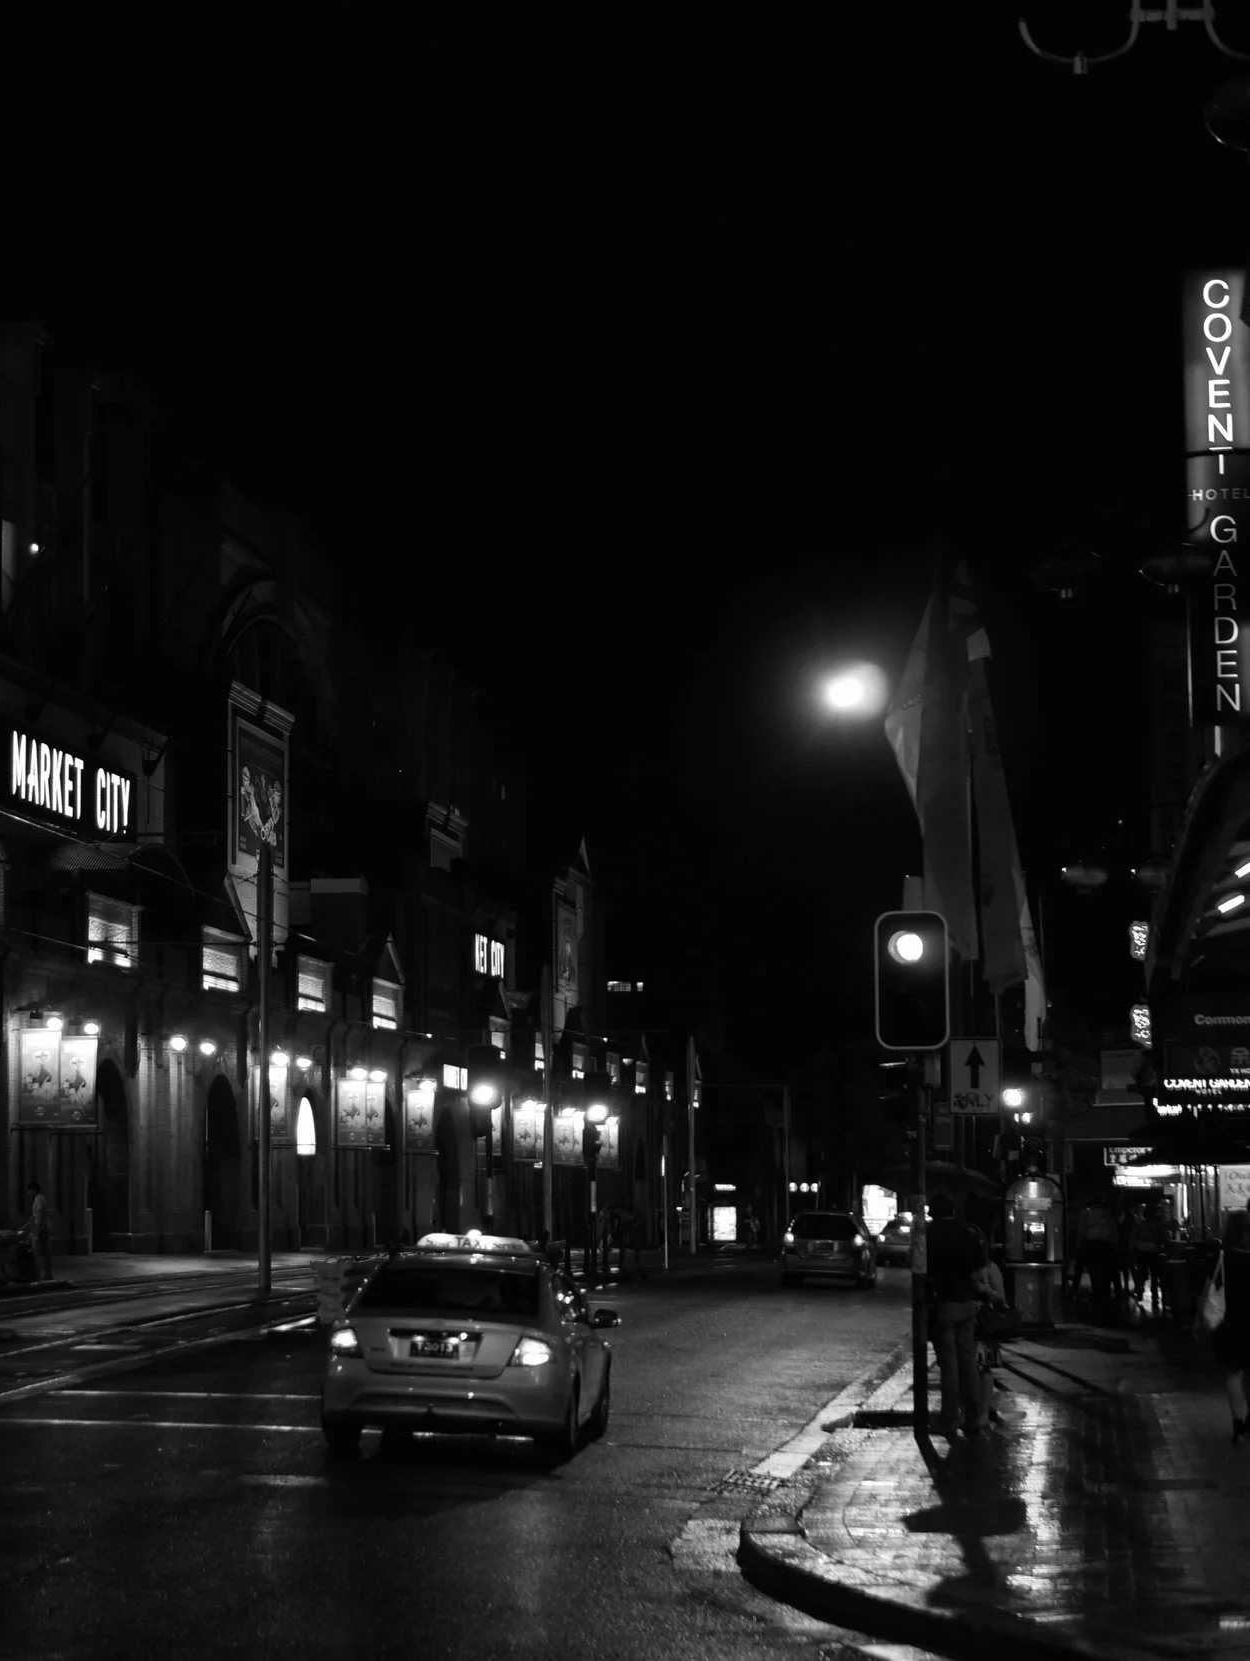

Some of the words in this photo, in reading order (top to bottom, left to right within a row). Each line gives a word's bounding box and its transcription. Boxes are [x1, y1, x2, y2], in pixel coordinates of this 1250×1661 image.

[1202, 278, 1233, 475] COVENT
[1192, 487, 1250, 502] HOTEL
[1209, 514, 1241, 713] GARDEN
[10, 729, 85, 821] MARKET
[95, 767, 131, 835] CITY
